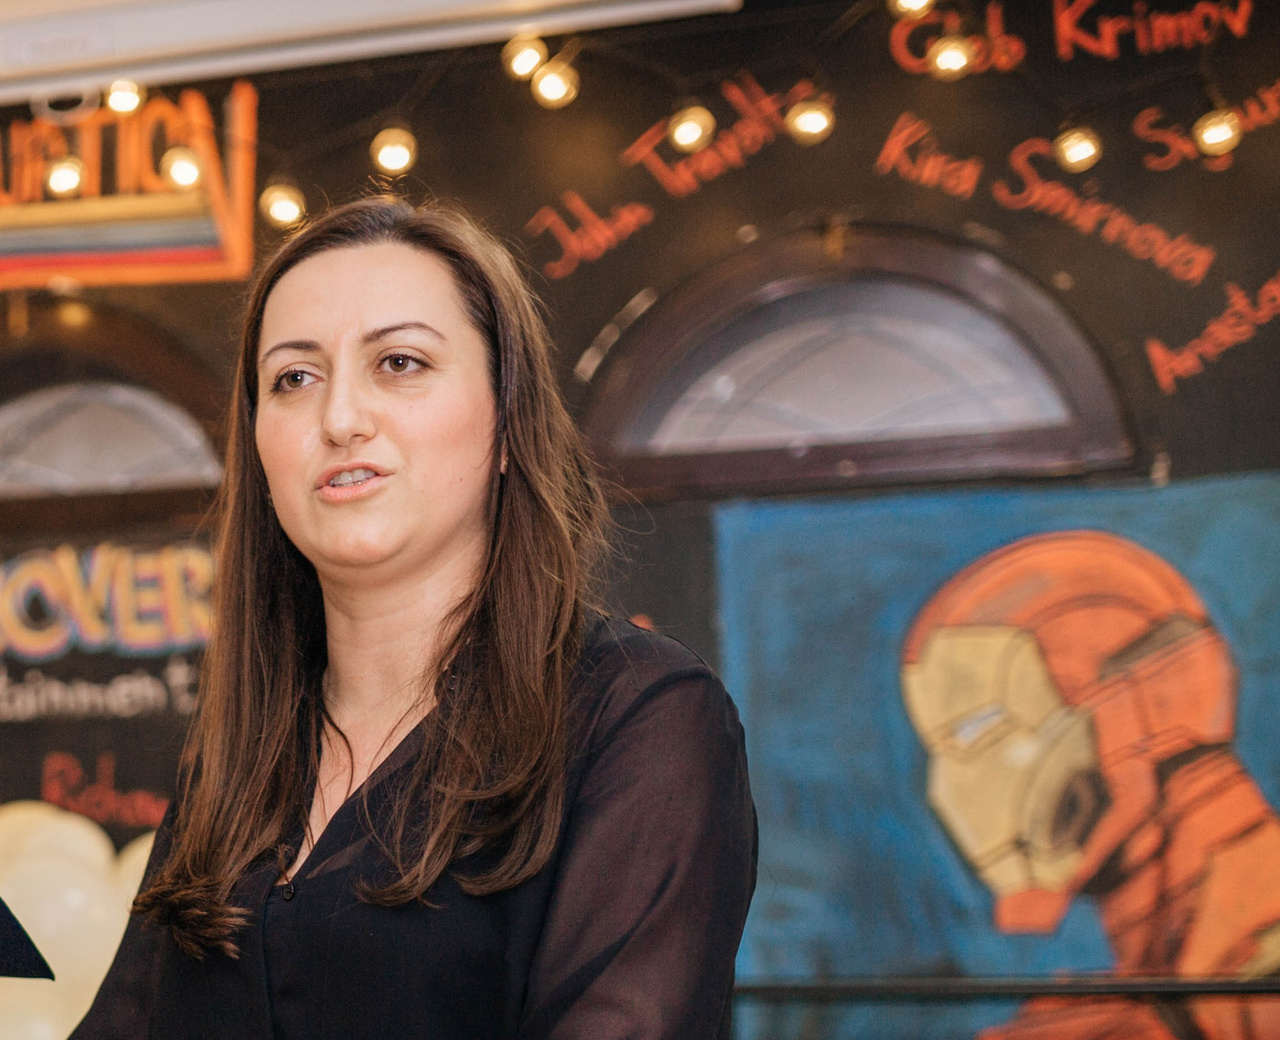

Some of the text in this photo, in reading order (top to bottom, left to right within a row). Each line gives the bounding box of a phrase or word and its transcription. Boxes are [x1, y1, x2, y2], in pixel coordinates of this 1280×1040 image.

[1053, 0, 1252, 61] Krimov
[876, 112, 1216, 286] Kira Smirnova
